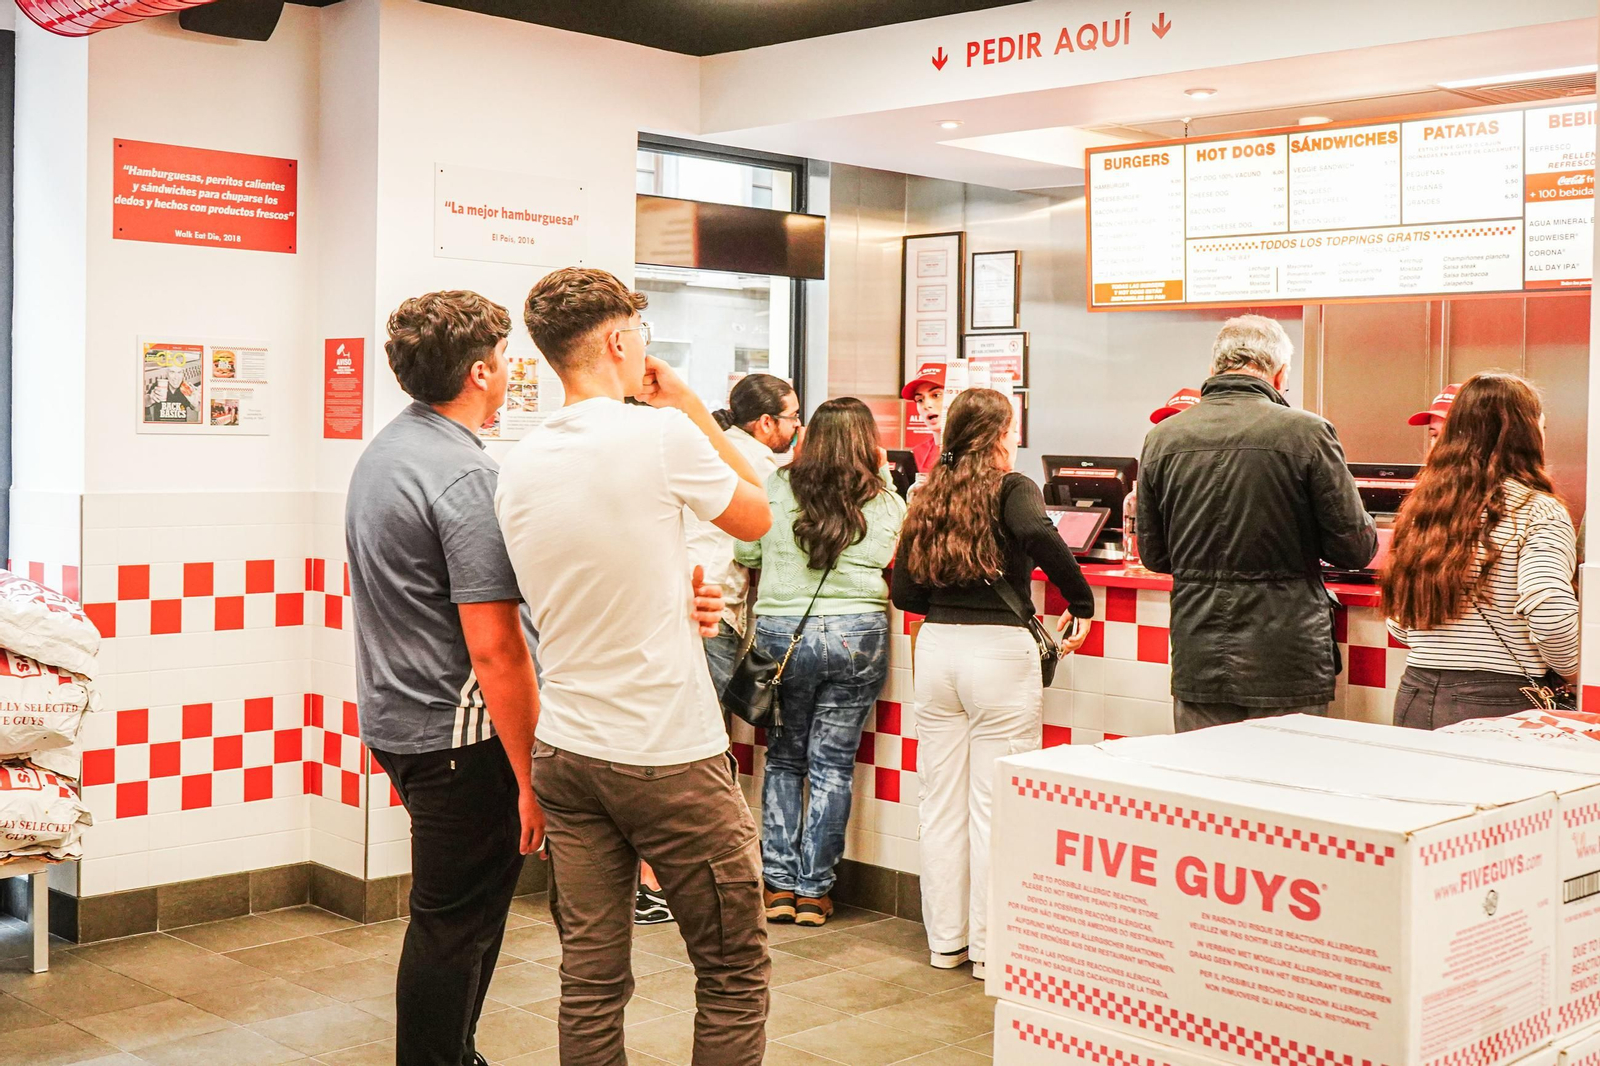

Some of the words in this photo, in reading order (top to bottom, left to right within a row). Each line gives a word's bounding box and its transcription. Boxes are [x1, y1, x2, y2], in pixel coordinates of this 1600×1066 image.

[966, 32, 1042, 67] PEDIR
[1053, 11, 1132, 55] AQUÍ
[1423, 120, 1500, 141] PATATAS
[1196, 147, 1227, 162] HOT
[1232, 142, 1275, 158] DOGS
[1290, 130, 1398, 153] SÁNDWICHES
[1103, 152, 1170, 170] BURGERS
[131, 183, 139, 193] y
[140, 182, 197, 197] sándwiches
[198, 188, 220, 200] para
[221, 191, 263, 204] chuparse
[264, 194, 278, 205] los
[205, 175, 243, 188] perritos
[244, 179, 286, 192] calientes
[1538, 189, 1556, 198] 100
[114, 194, 144, 207] dedos
[146, 200, 153, 210] y
[154, 199, 188, 212] hechos
[189, 204, 206, 212] con
[207, 205, 255, 218] productos
[256, 208, 295, 221] frescos”
[467, 204, 499, 220] mejor
[1553, 218, 1588, 226] MINERAL
[175, 229, 193, 238] Walk
[194, 231, 206, 239] Eat
[207, 232, 222, 242] Die,
[223, 234, 242, 242] 2018
[492, 233, 498, 241] El
[518, 236, 535, 245] 2016
[1260, 239, 1297, 250] TODOS
[1300, 237, 1322, 248] LOS
[1326, 234, 1384, 247] TOPPINGS
[1386, 230, 1430, 244] GRATIS
[160, 410, 186, 418] BASICS
[161, 402, 182, 410] BACK
[24, 702, 78, 714] SELECTED
[13, 716, 44, 727] GUYS
[1056, 828, 1157, 887] FIVE
[1033, 873, 1044, 881] DUE
[1054, 878, 1081, 890] POSSIBLE
[1083, 885, 1111, 897] ALLERGIC
[1022, 881, 1042, 892] PLEASE
[1044, 886, 1052, 894] DO
[1066, 892, 1090, 903] REMOVE
[1091, 898, 1118, 910] PEANUTS
[1120, 904, 1136, 914] FROM
[1008, 901, 1020, 909] POR
[1020, 904, 1038, 914] FAVOR
[1053, 912, 1076, 924] REMOVA
[1119, 928, 1128, 936] DO
[1006, 924, 1022, 934] BITTE
[1023, 929, 1039, 938] KEINE
[1071, 942, 1083, 950] AUS
[1084, 944, 1096, 952] DEM
[1098, 948, 1136, 962] RESTAURANT
[1011, 951, 1022, 960] POR
[1024, 955, 1042, 964] FAVOR
[1043, 960, 1052, 968] NO
[1053, 963, 1072, 974] SAQUE
[1074, 968, 1085, 978] LOS
[1086, 972, 1126, 988] CACAHUETES
[1127, 982, 1135, 990] DE
[1197, 940, 1204, 948] IN
[1206, 942, 1236, 956] VERBAND
[1238, 950, 1252, 958] MET
[1294, 963, 1342, 980] ALLERGISCHE
[1189, 950, 1212, 962] GRAAG
[1214, 956, 1232, 966] GEEN
[1261, 968, 1274, 976] VAN
[1276, 972, 1290, 980] HET
[1292, 974, 1337, 992] RESTAURANT
[1205, 983, 1220, 992] NON
[1221, 987, 1260, 1002] RIMUOVERE
[1275, 1001, 1308, 1014] ARACHIDI
[1309, 1009, 1322, 1018] DAL
